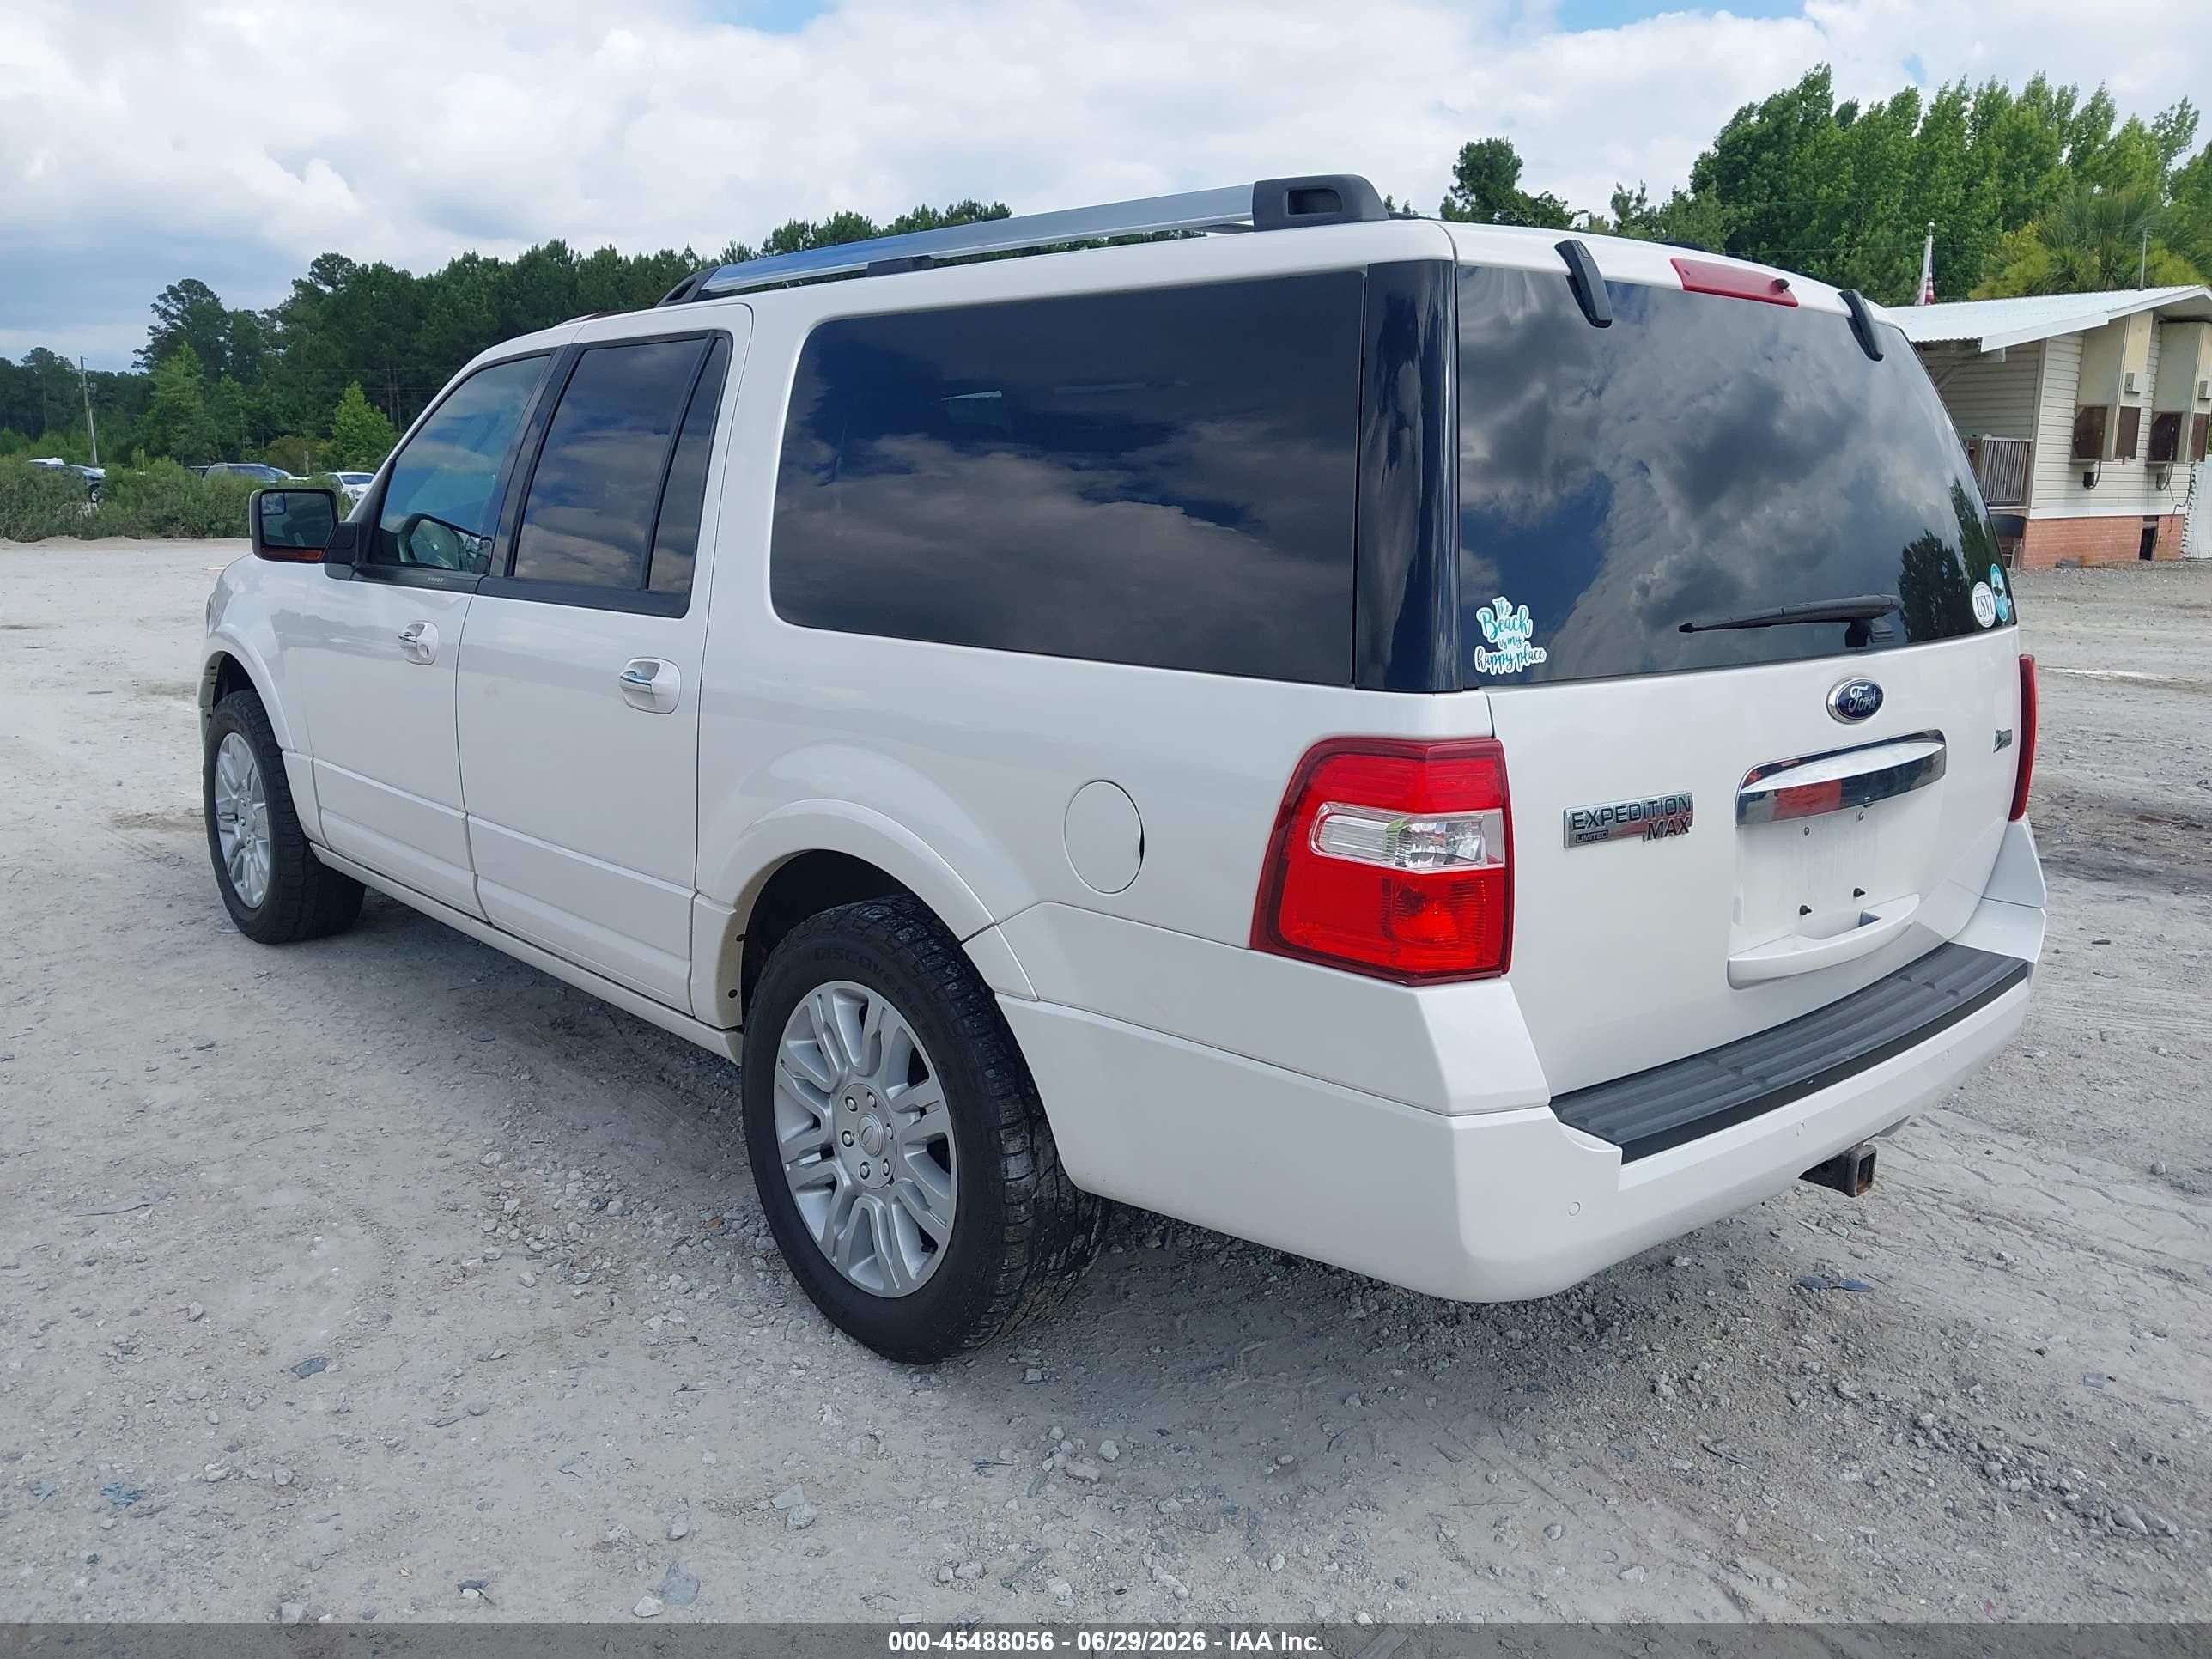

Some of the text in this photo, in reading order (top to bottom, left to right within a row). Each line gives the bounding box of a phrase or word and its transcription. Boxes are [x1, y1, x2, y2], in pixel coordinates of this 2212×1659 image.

[1494, 599, 1511, 616] The
[1479, 607, 1532, 640] Beach
[1498, 635, 1522, 649] is my
[1476, 643, 1546, 672] happy place
[1848, 685, 1877, 713] Ford
[1571, 793, 1692, 830] EXPEDITION
[1576, 830, 1608, 843] LIMITED
[1644, 817, 1690, 841] MAX
